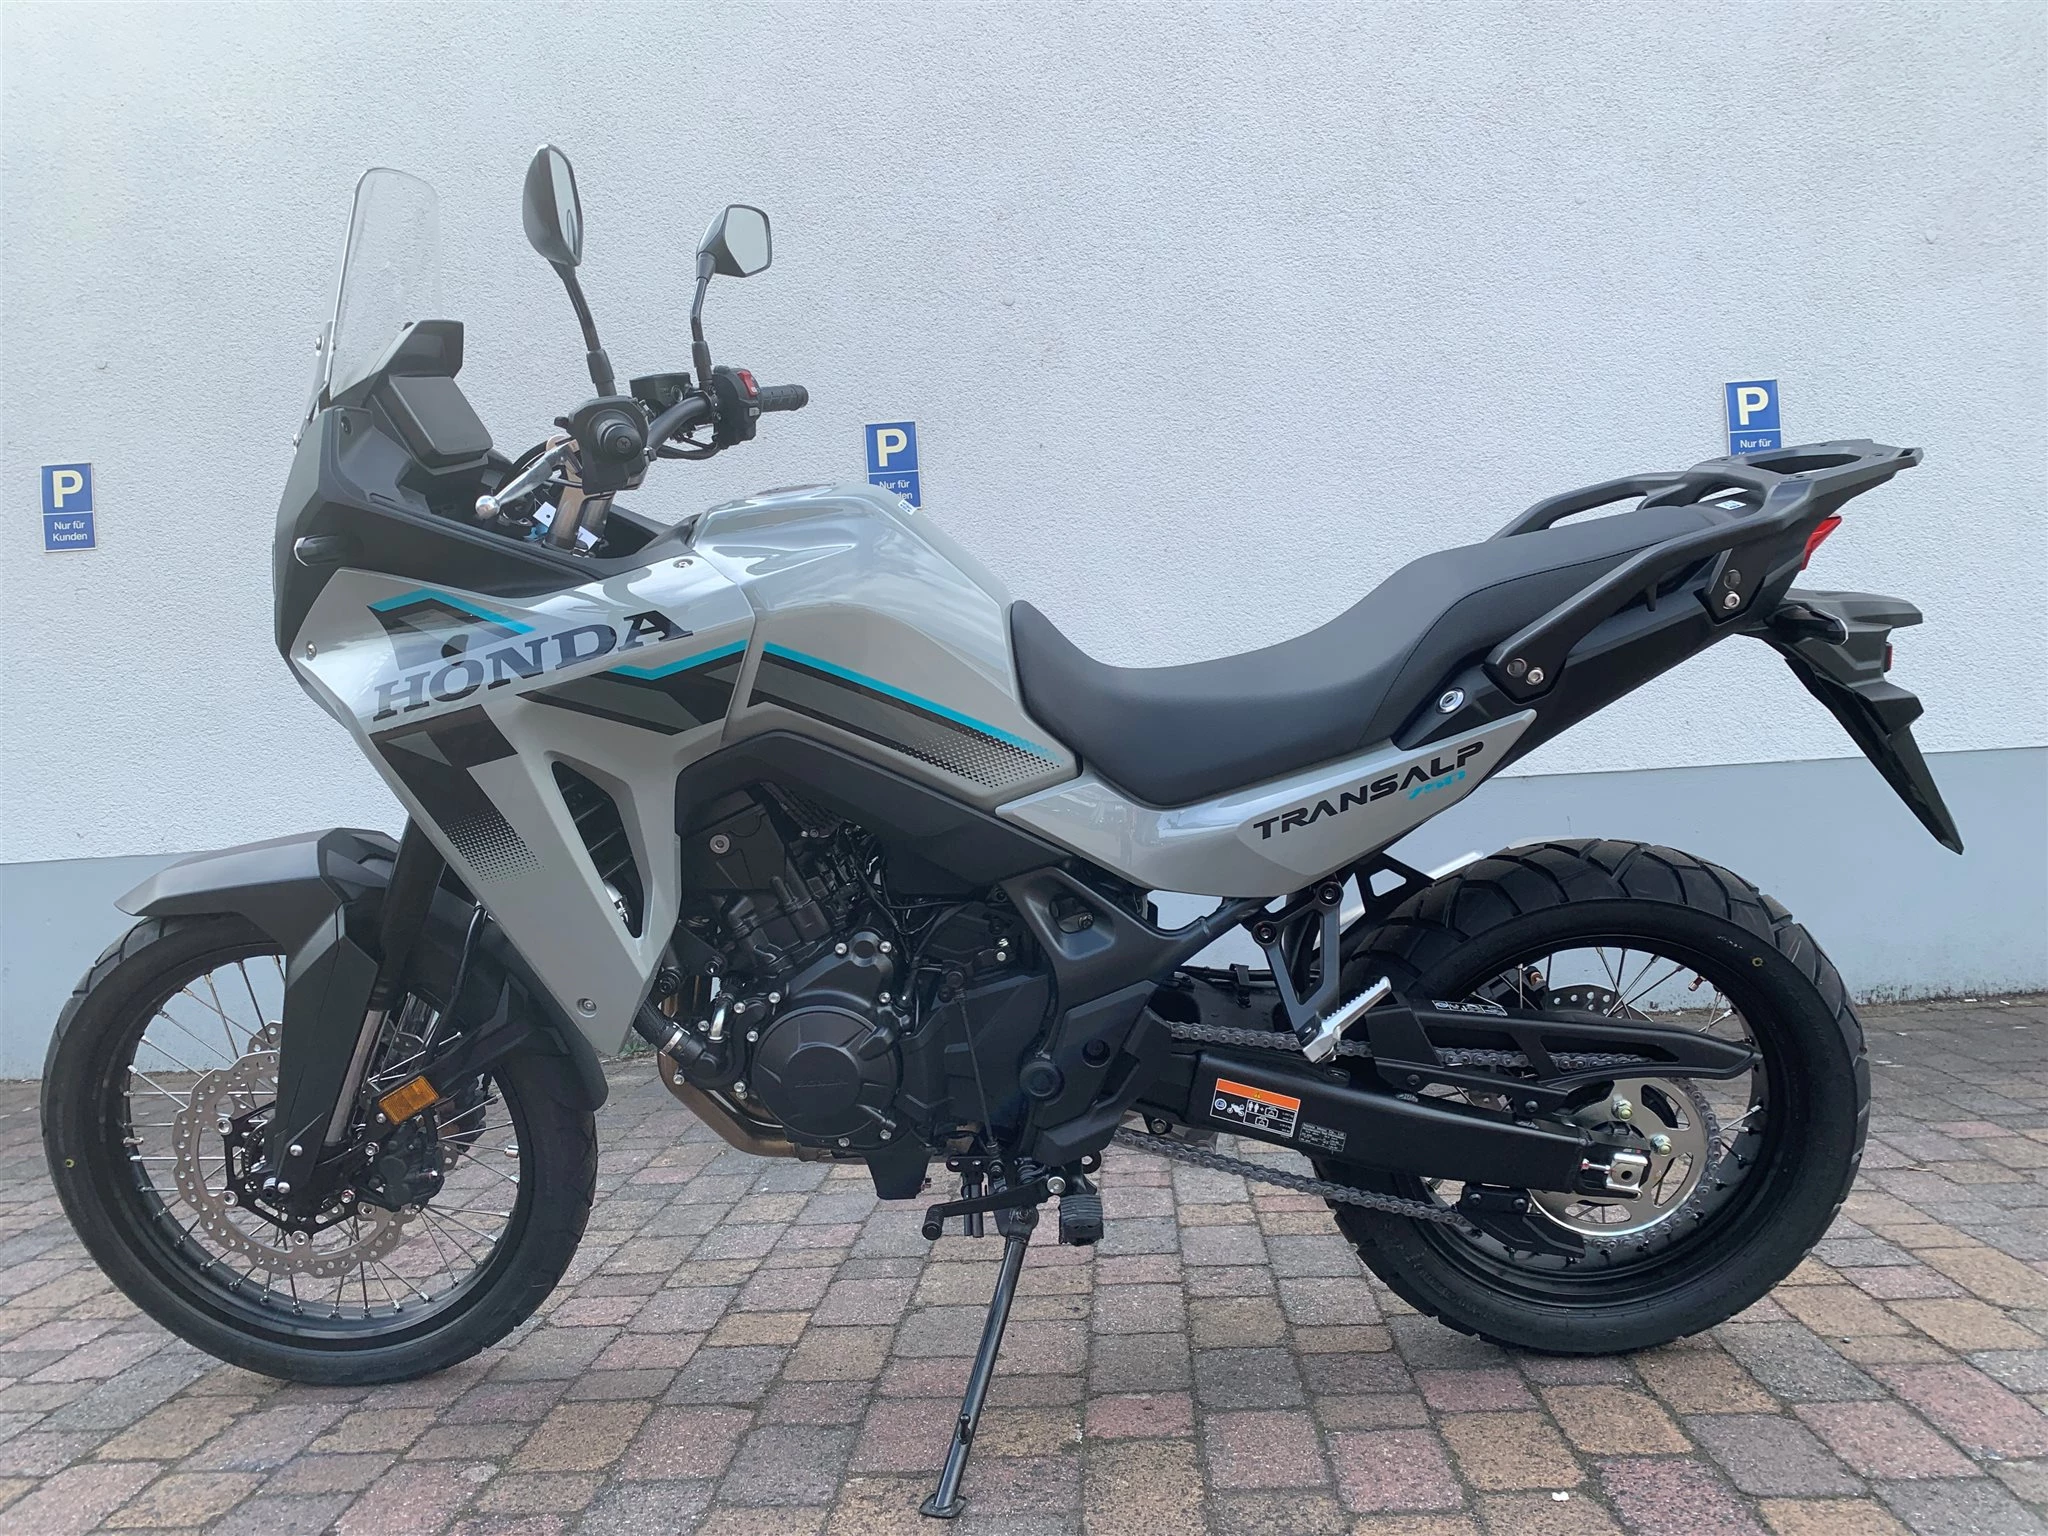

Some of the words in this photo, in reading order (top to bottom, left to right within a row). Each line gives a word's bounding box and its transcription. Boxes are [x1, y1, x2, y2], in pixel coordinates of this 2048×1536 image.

[1737, 387, 1769, 426] P
[877, 428, 907, 467] P
[1740, 440, 1757, 449] Nur
[1759, 438, 1772, 447] für
[52, 470, 83, 508] P
[879, 481, 896, 489] Nur
[897, 479, 910, 489] für
[52, 532, 88, 542] Kunden
[54, 521, 71, 531] Nur
[73, 520, 85, 529] für
[373, 610, 694, 722] HONDA
[1253, 741, 1484, 840] TRANSALP
